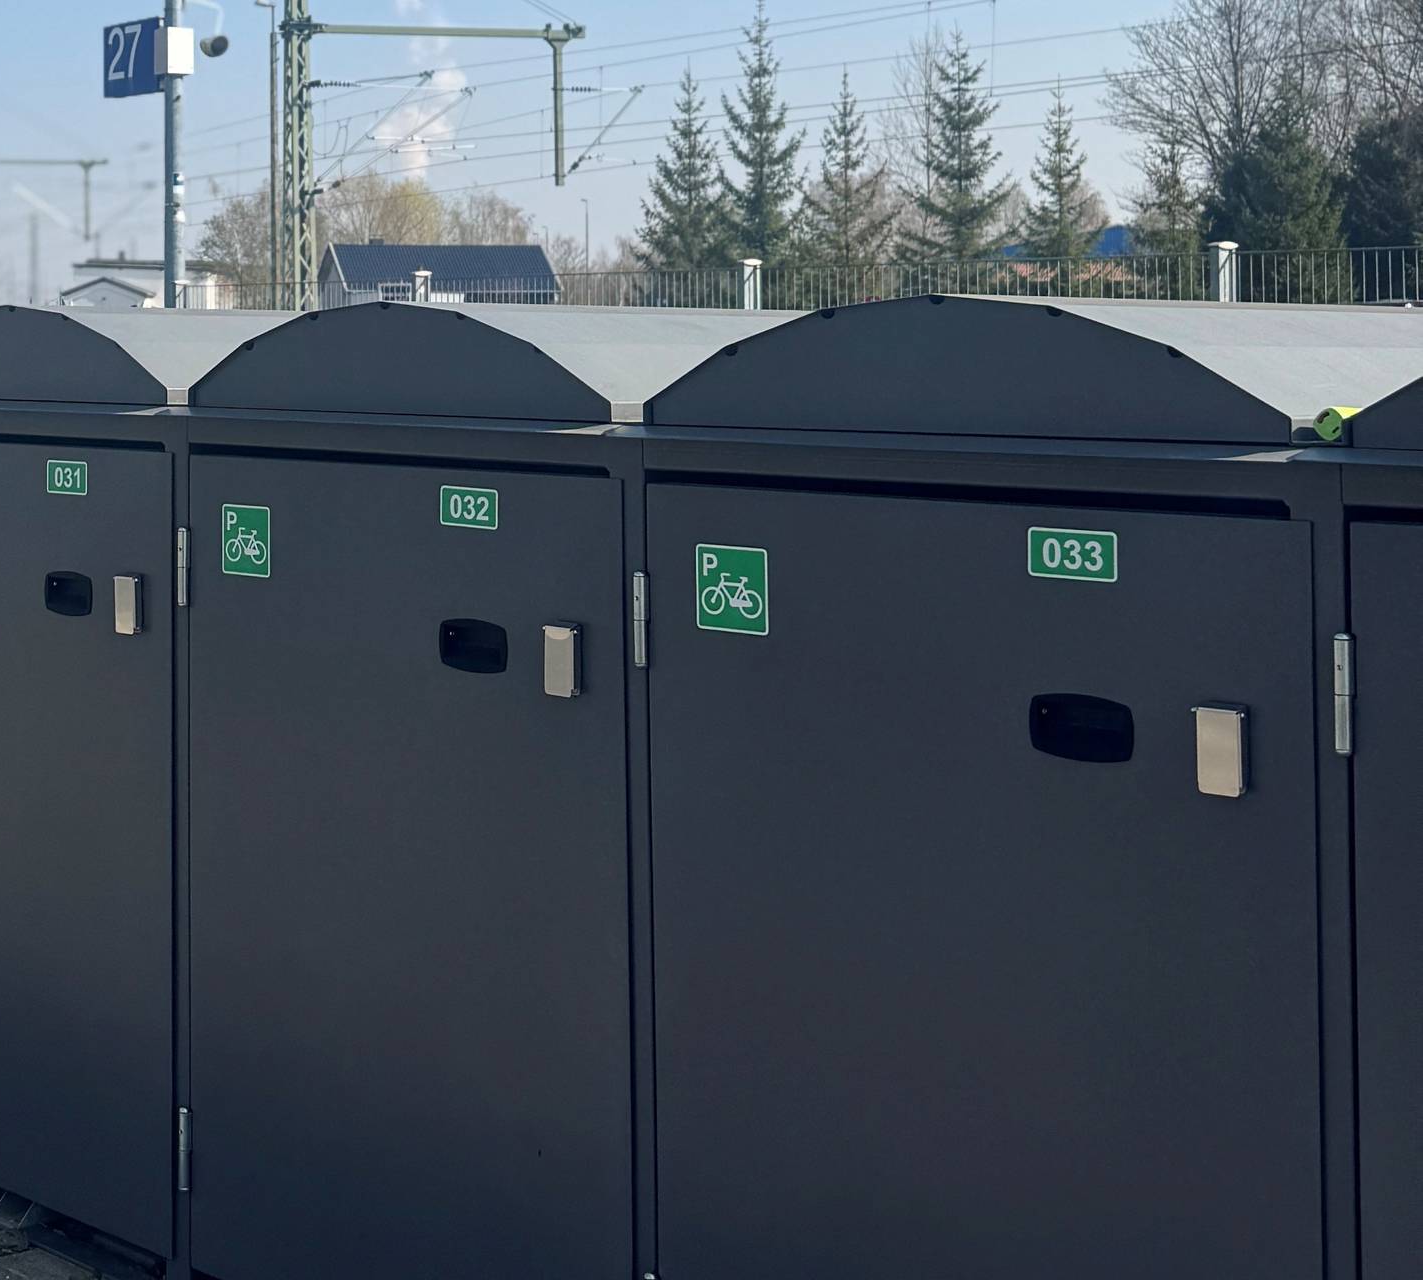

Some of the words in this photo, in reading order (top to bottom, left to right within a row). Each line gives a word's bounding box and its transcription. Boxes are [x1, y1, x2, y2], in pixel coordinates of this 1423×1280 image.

[108, 24, 141, 80] 27
[54, 466, 81, 489] 031
[449, 494, 489, 521] 032
[226, 511, 237, 531] P
[703, 552, 718, 576] P
[1042, 537, 1103, 571] 033
